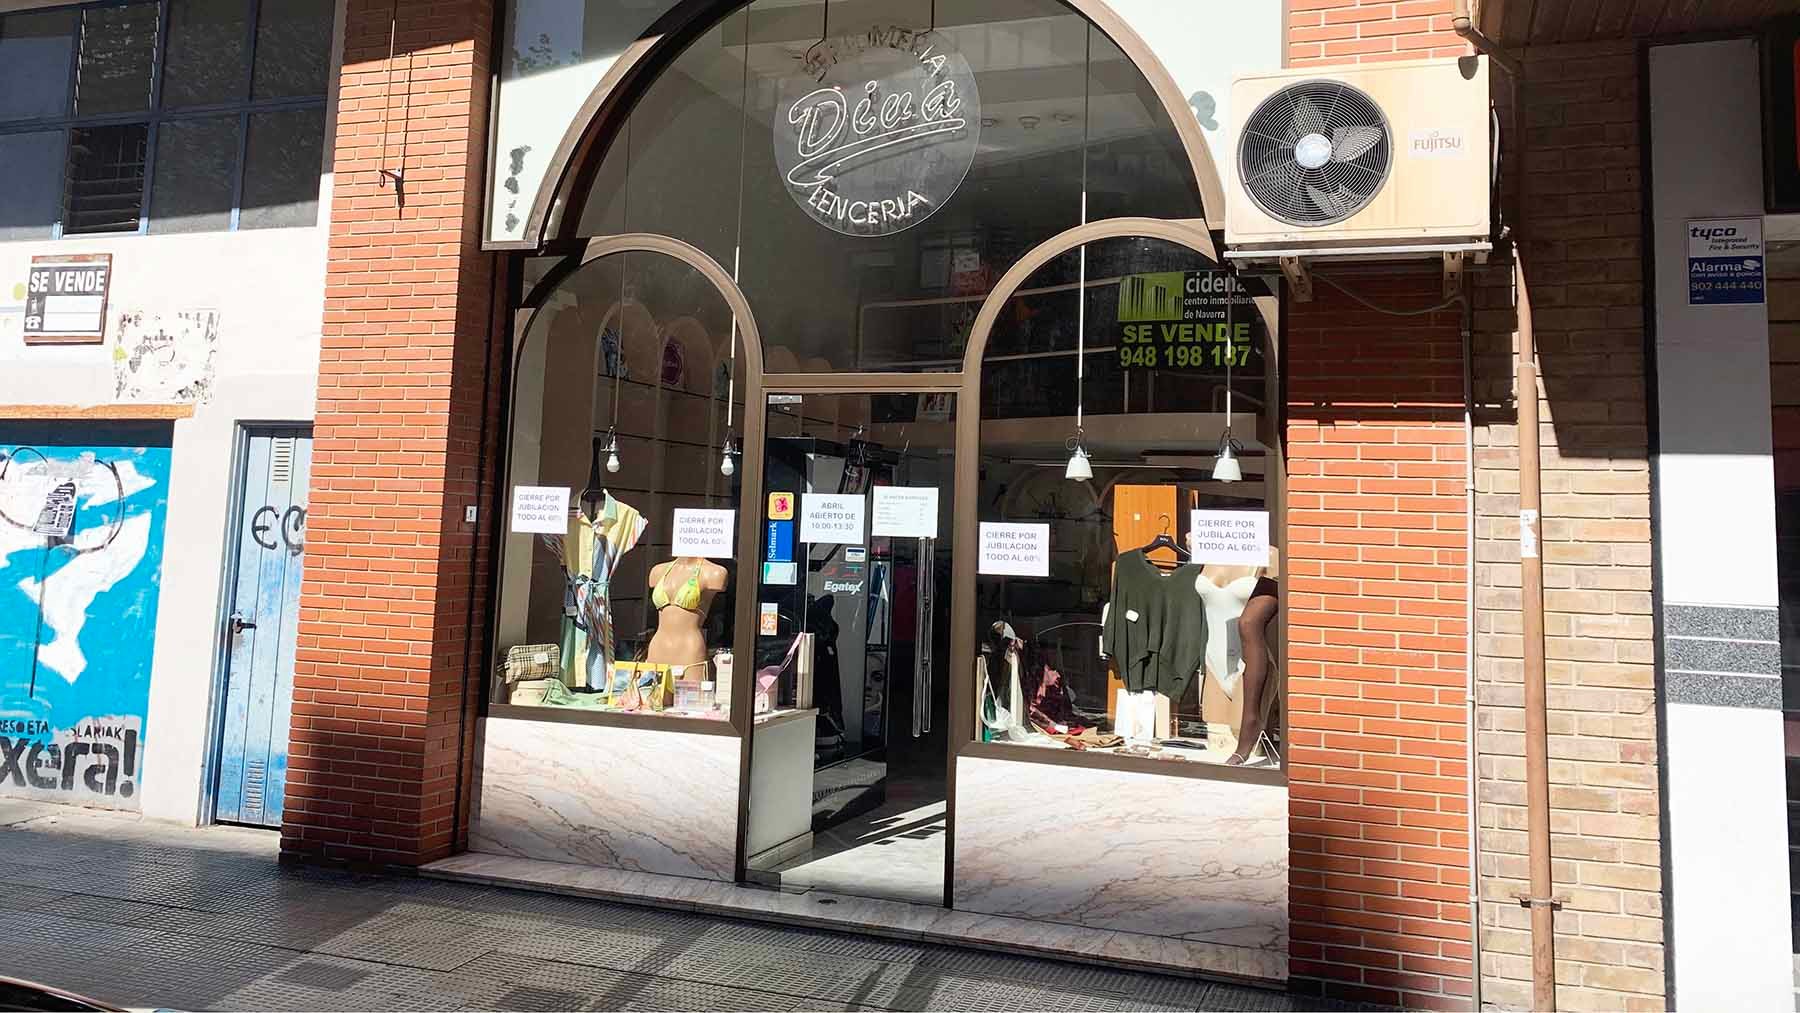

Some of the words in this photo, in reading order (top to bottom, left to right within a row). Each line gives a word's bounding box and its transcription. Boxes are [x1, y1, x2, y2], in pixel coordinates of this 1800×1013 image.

[1413, 136, 1461, 153] FUJITSU
[807, 186, 928, 224] LENCERIA
[1690, 227, 1737, 240] tyco
[1690, 262, 1742, 273] Alarma
[30, 271, 49, 292] SE
[55, 270, 106, 292] VENDE
[1184, 296, 1208, 306] centro
[1184, 309, 1194, 319] de
[1195, 309, 1226, 319] Navarra
[1122, 323, 1153, 343] SE
[1160, 322, 1250, 343] VENDE
[1120, 346, 1158, 367] 948
[1164, 345, 1203, 367] 198
[1211, 345, 1251, 367] 187
[517, 513, 537, 521] TODO
[537, 513, 546, 521] AL
[809, 512, 844, 520] ABIERTO
[844, 512, 856, 520] DE
[1197, 519, 1232, 528] CIERRE
[1234, 520, 1255, 529] POR
[985, 531, 1017, 540] CIERRE
[1018, 532, 1038, 540] POR
[1197, 530, 1256, 540] JUBILACION
[679, 537, 699, 545] TODO
[700, 537, 709, 545] AL
[768, 521, 777, 560] Selmark
[985, 542, 1038, 551] JUBILACION
[1198, 542, 1225, 551] TODO
[1226, 543, 1239, 551] AL
[985, 552, 1010, 561] TODO
[1011, 553, 1021, 562] AL
[823, 580, 864, 595] Egatex
[27, 720, 49, 735] ETA
